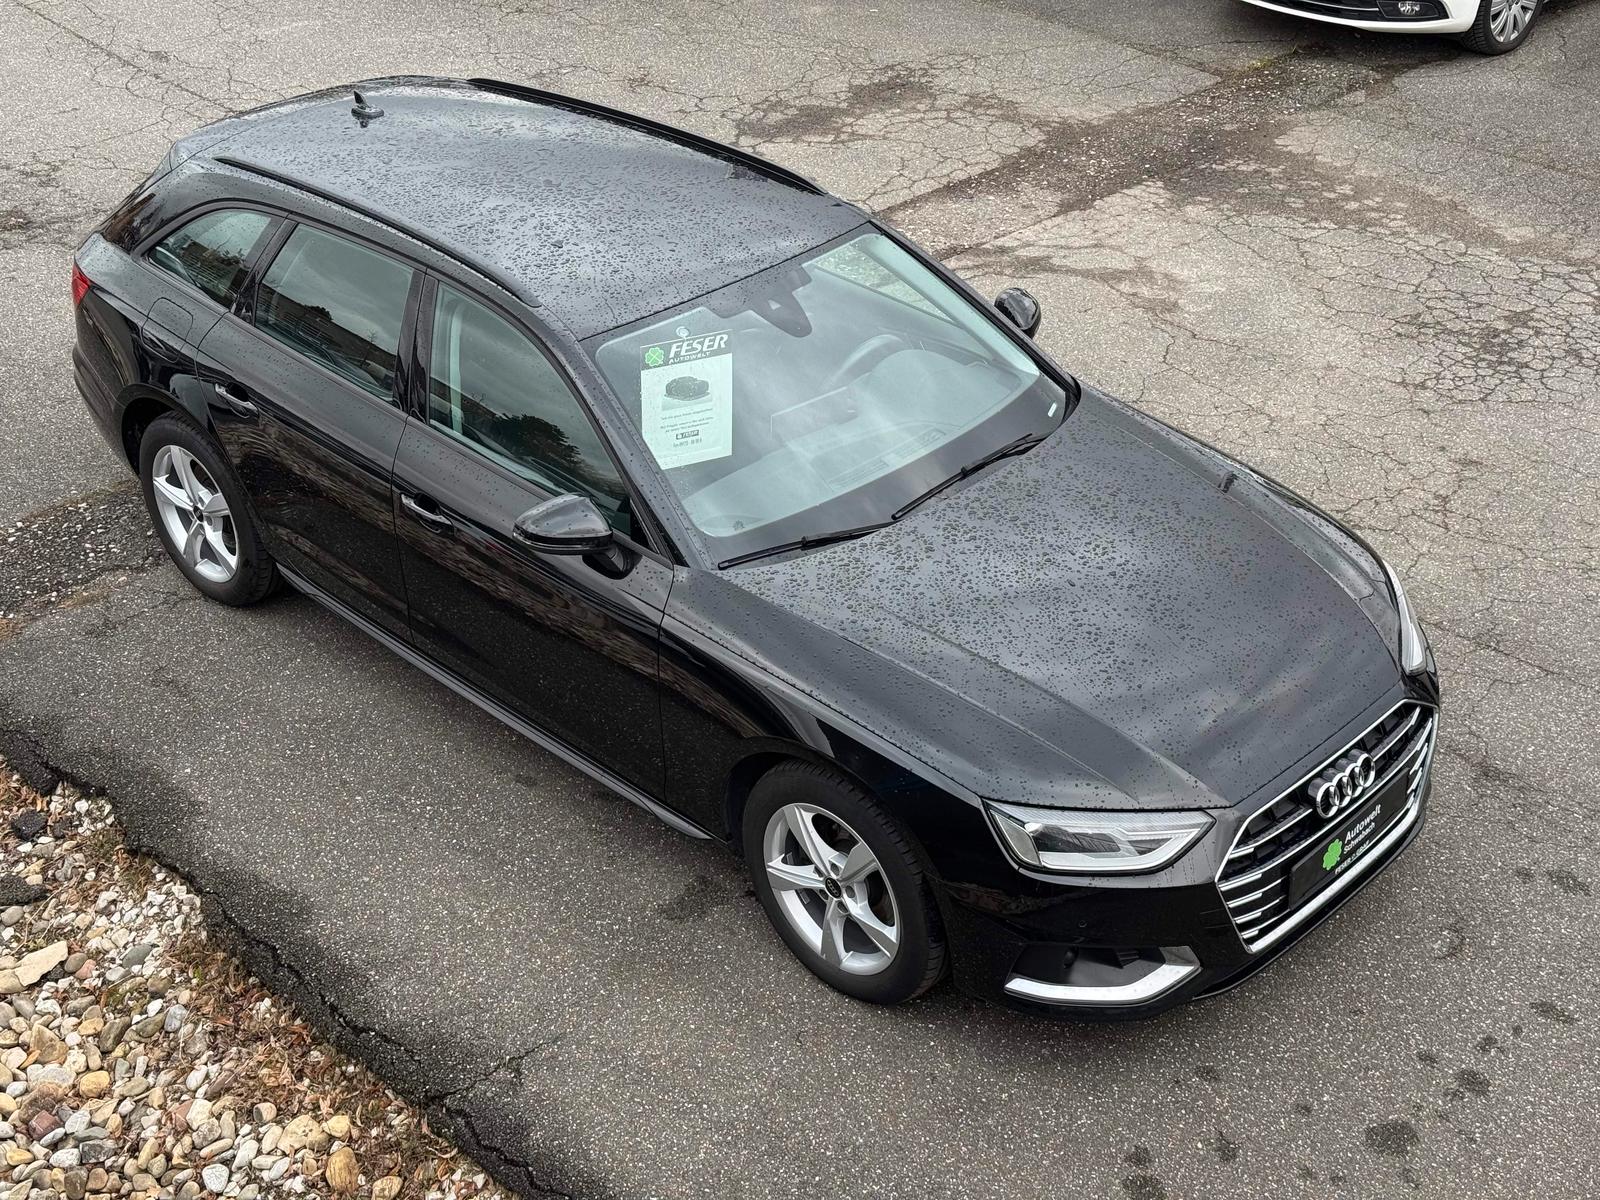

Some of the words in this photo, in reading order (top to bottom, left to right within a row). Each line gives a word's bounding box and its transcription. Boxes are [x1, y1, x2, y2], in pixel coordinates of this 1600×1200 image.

[668, 351, 711, 364] AUTOWELT
[669, 334, 729, 359] FESER
[1344, 822, 1376, 854] Schwabach
[1345, 804, 1381, 844] Autowelt
